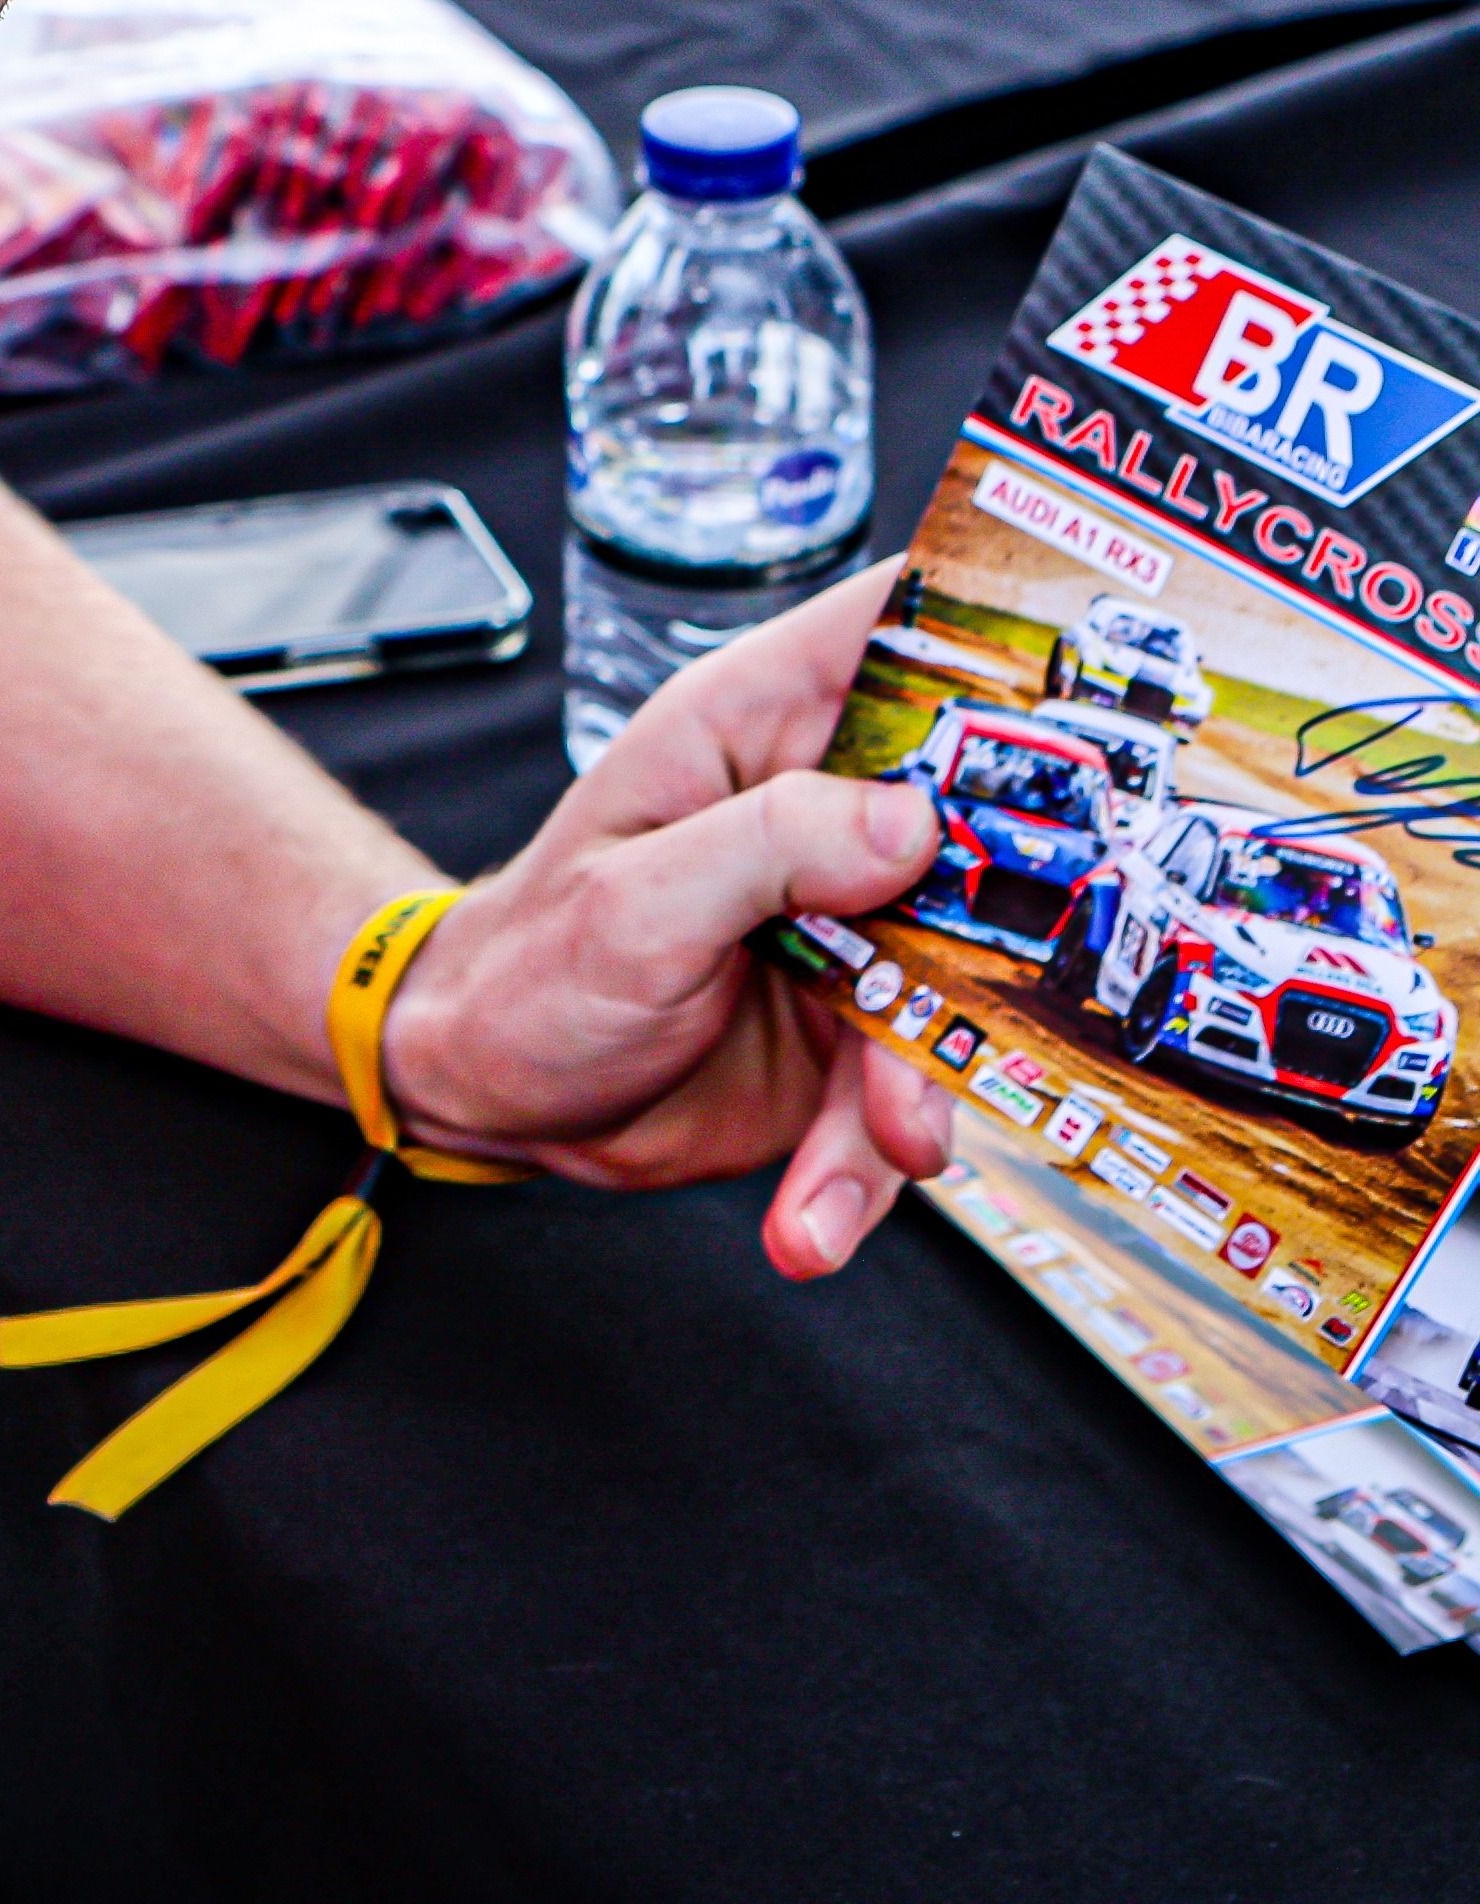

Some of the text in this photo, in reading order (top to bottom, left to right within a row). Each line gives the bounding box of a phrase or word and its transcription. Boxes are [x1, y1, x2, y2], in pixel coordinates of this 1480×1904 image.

[1193, 288, 1385, 468] BR
[1206, 402, 1349, 492] BIBARACING
[989, 477, 1162, 588] AUDI A1 RX3
